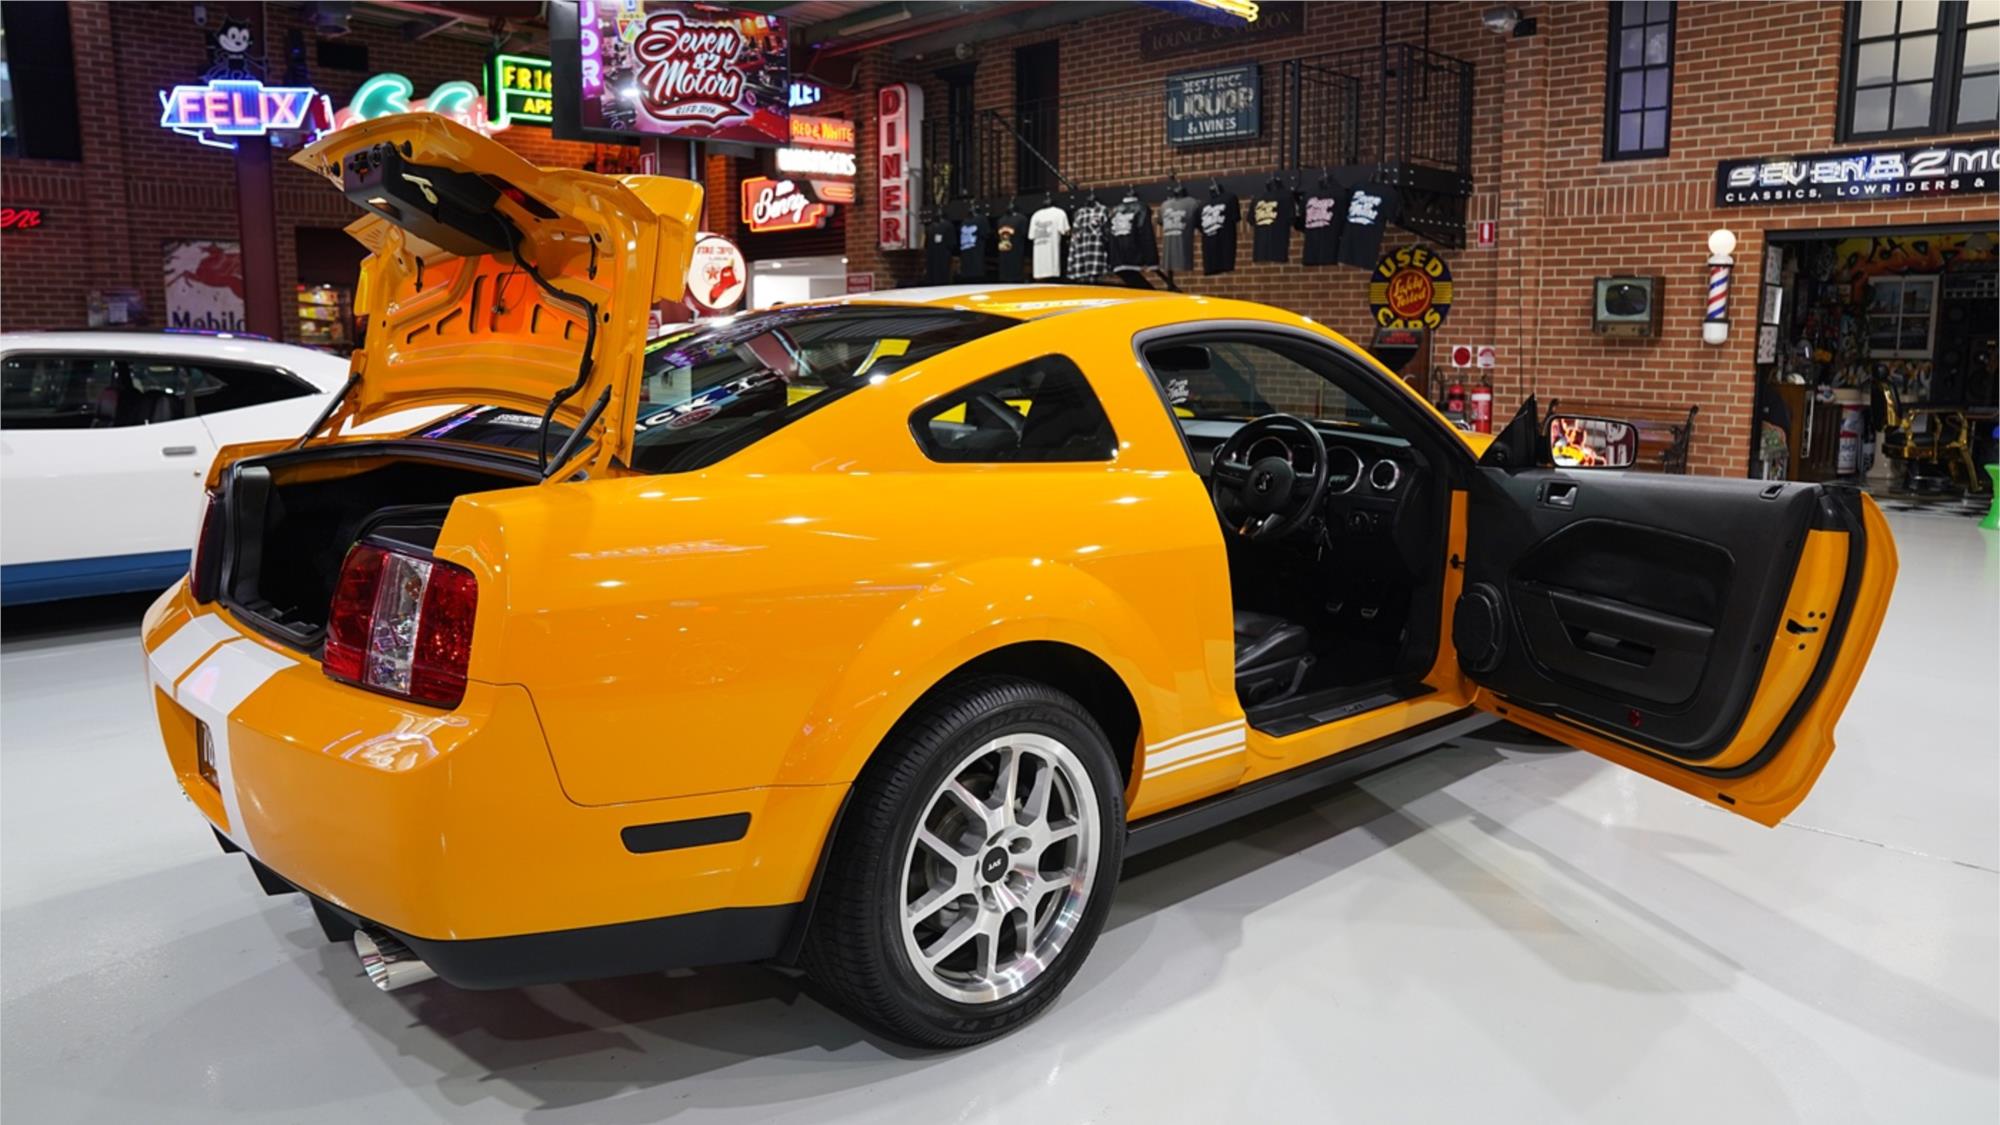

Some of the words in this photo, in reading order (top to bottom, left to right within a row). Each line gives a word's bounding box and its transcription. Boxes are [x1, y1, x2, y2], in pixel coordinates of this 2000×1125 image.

[640, 20, 735, 61] Seven
[693, 53, 721, 71] 82
[642, 61, 737, 101] Motors
[178, 93, 297, 124] FELIX
[1168, 87, 1255, 120] LIQUOR
[792, 119, 810, 136] RED
[821, 122, 854, 142] WHITE
[1200, 117, 1237, 133] WINES
[881, 90, 901, 243] DINER
[1725, 188, 1822, 203] CLASSICS,
[1837, 179, 1960, 197] LOWRIDERS
[1974, 177, 1985, 188] &
[1379, 250, 1443, 278] USED
[1378, 307, 1440, 329] CARS
